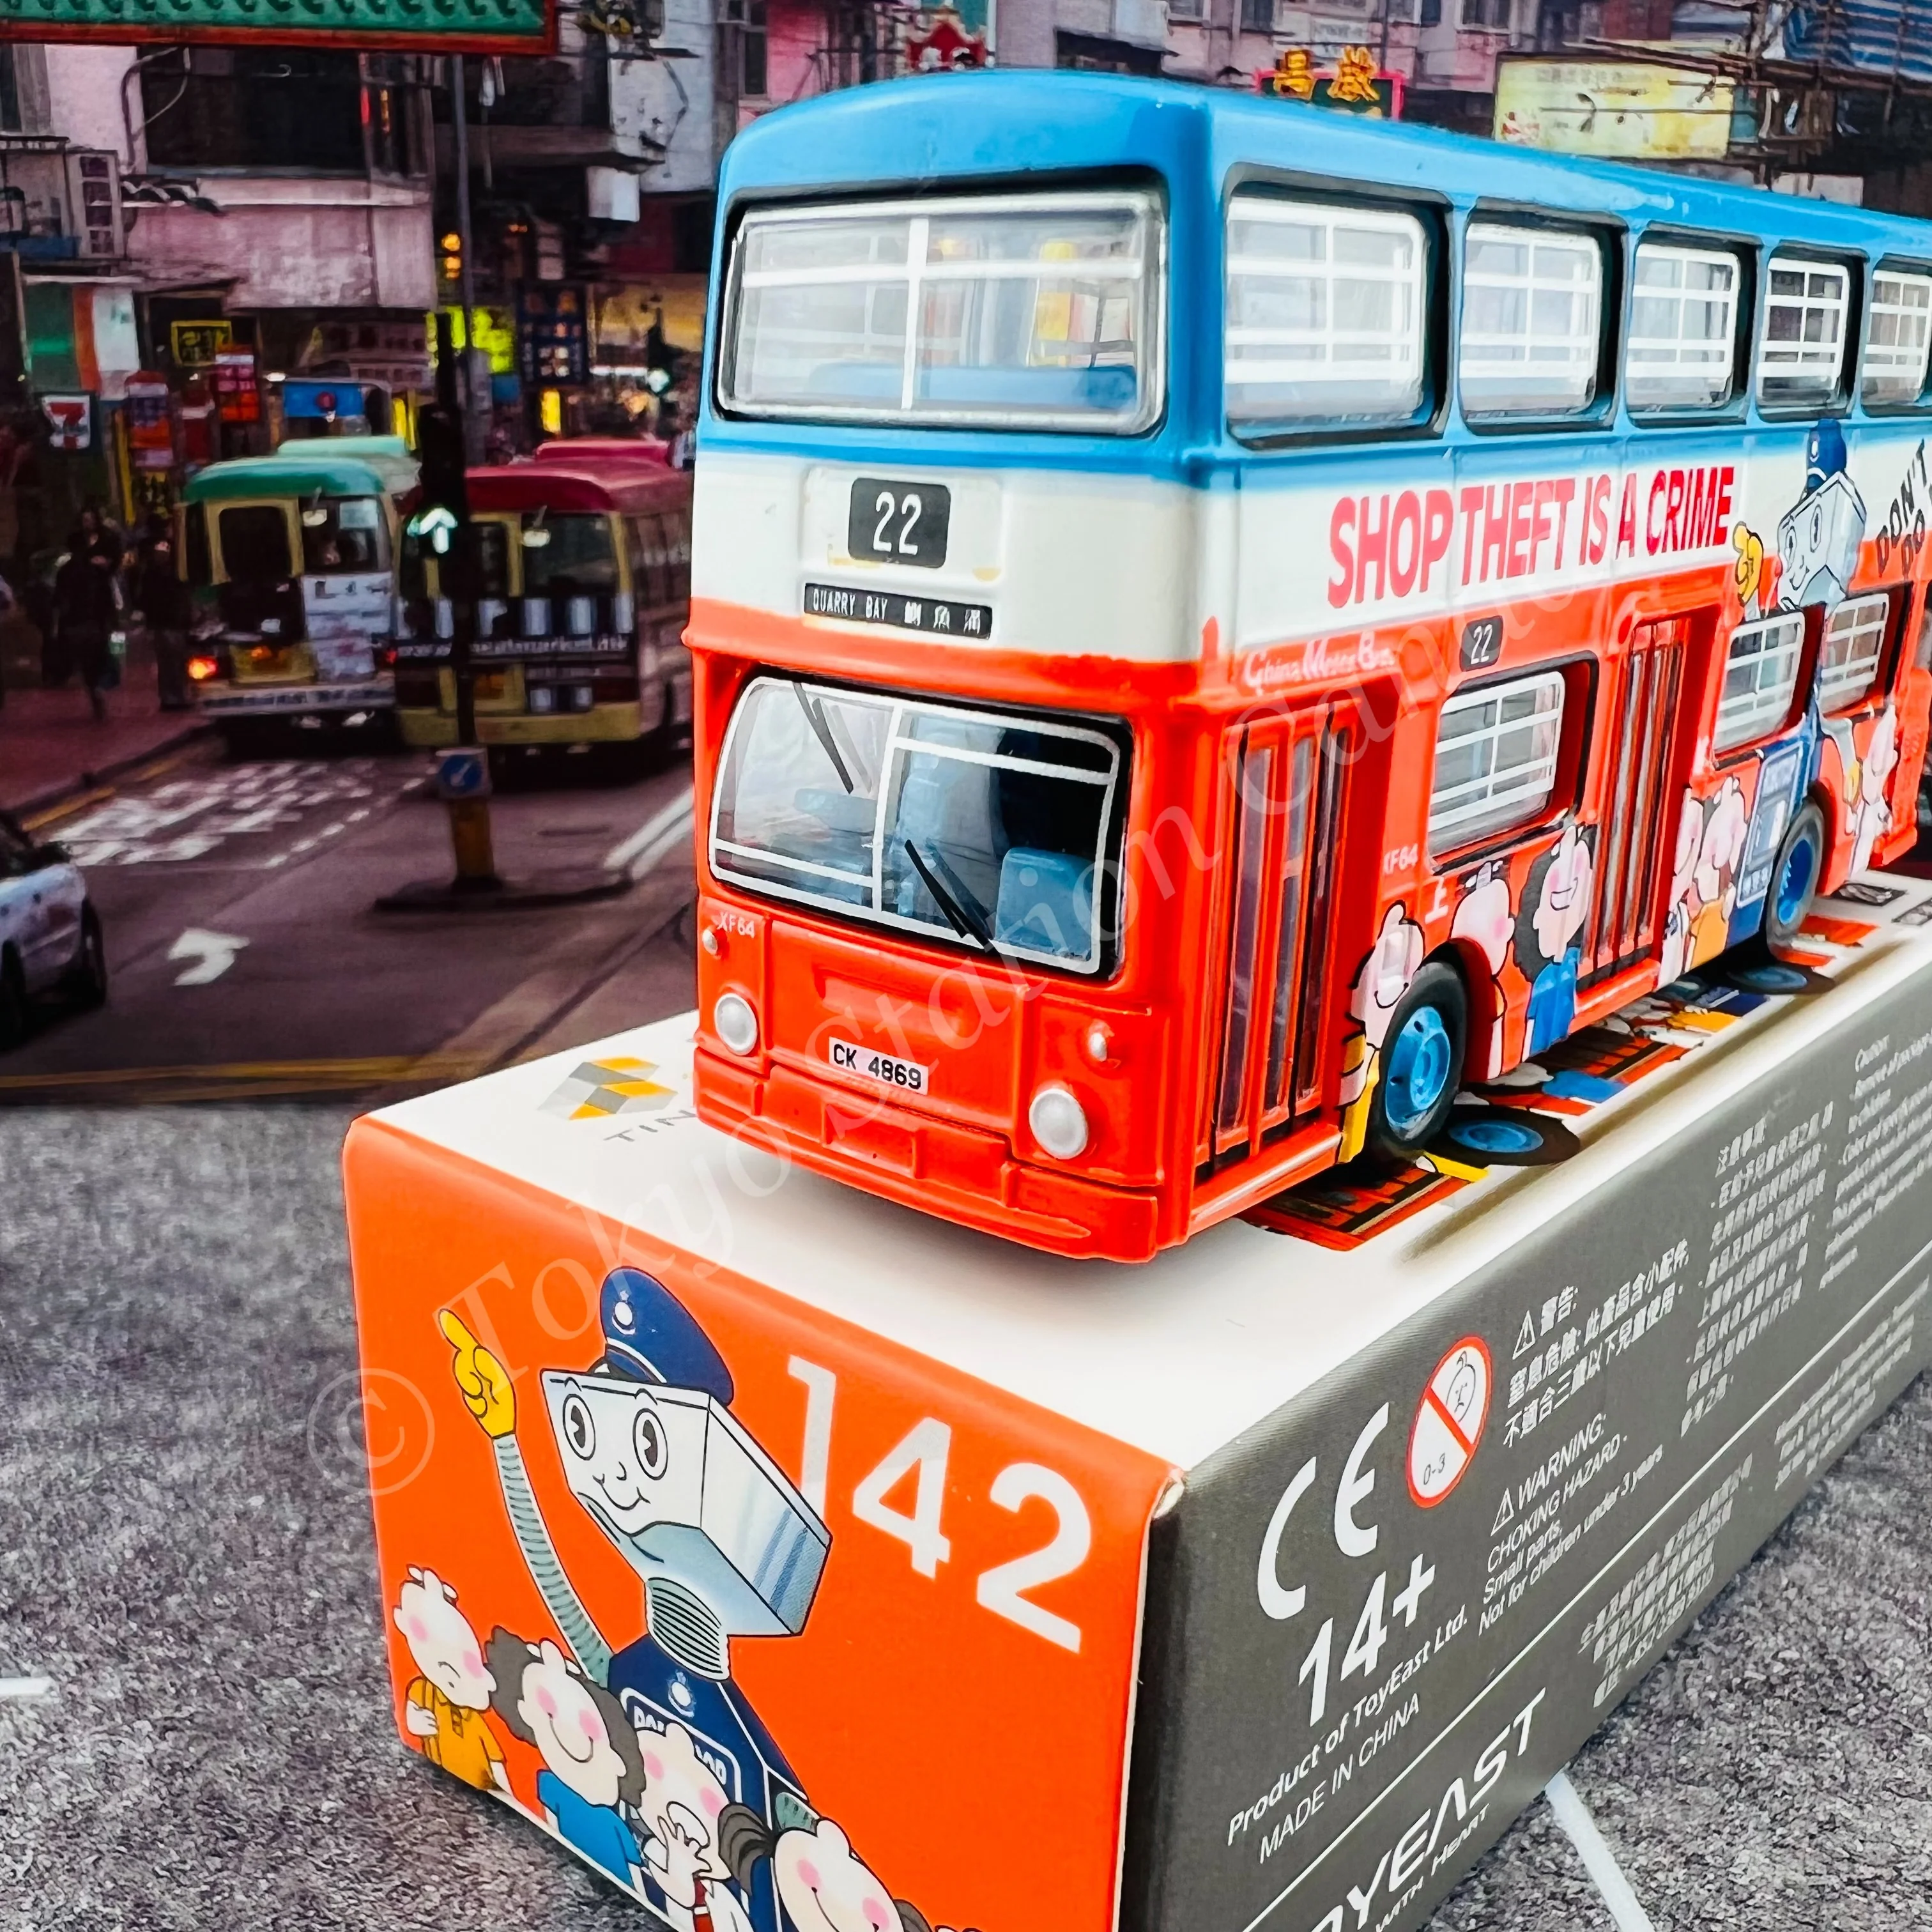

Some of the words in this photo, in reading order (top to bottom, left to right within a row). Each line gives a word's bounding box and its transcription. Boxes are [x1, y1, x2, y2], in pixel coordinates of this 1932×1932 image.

[873, 491, 922, 555] 22
[1328, 489, 1453, 608] SHOP
[1460, 477, 1575, 586] THEFT
[1579, 473, 1612, 567] IS
[1615, 472, 1637, 560] A
[1646, 466, 1735, 556] CRIME
[813, 588, 856, 617] QUARRY
[865, 595, 888, 621] BAY
[1471, 624, 1494, 665] 22
[717, 912, 755, 939] XF64
[833, 1043, 858, 1070] CK
[868, 1056, 922, 1091] 4869
[1518, 1413, 1607, 1510] WARNING:
[787, 1354, 1092, 1655] 142
[1487, 1489, 1561, 1573] CHOKING
[1478, 1593, 1506, 1637] Not
[1507, 1575, 1528, 1607] for
[1483, 1549, 1524, 1604] Small
[1298, 1553, 1436, 1727] 14+
[1227, 1744, 1321, 1846] Product
[1325, 1711, 1350, 1754] of
[1353, 1640, 1431, 1728] ToyEast
[1434, 1604, 1468, 1654] Ltd.
[1260, 1780, 1326, 1864] MADE
[1331, 1754, 1354, 1795] IN
[1358, 1692, 1420, 1767] CHINA
